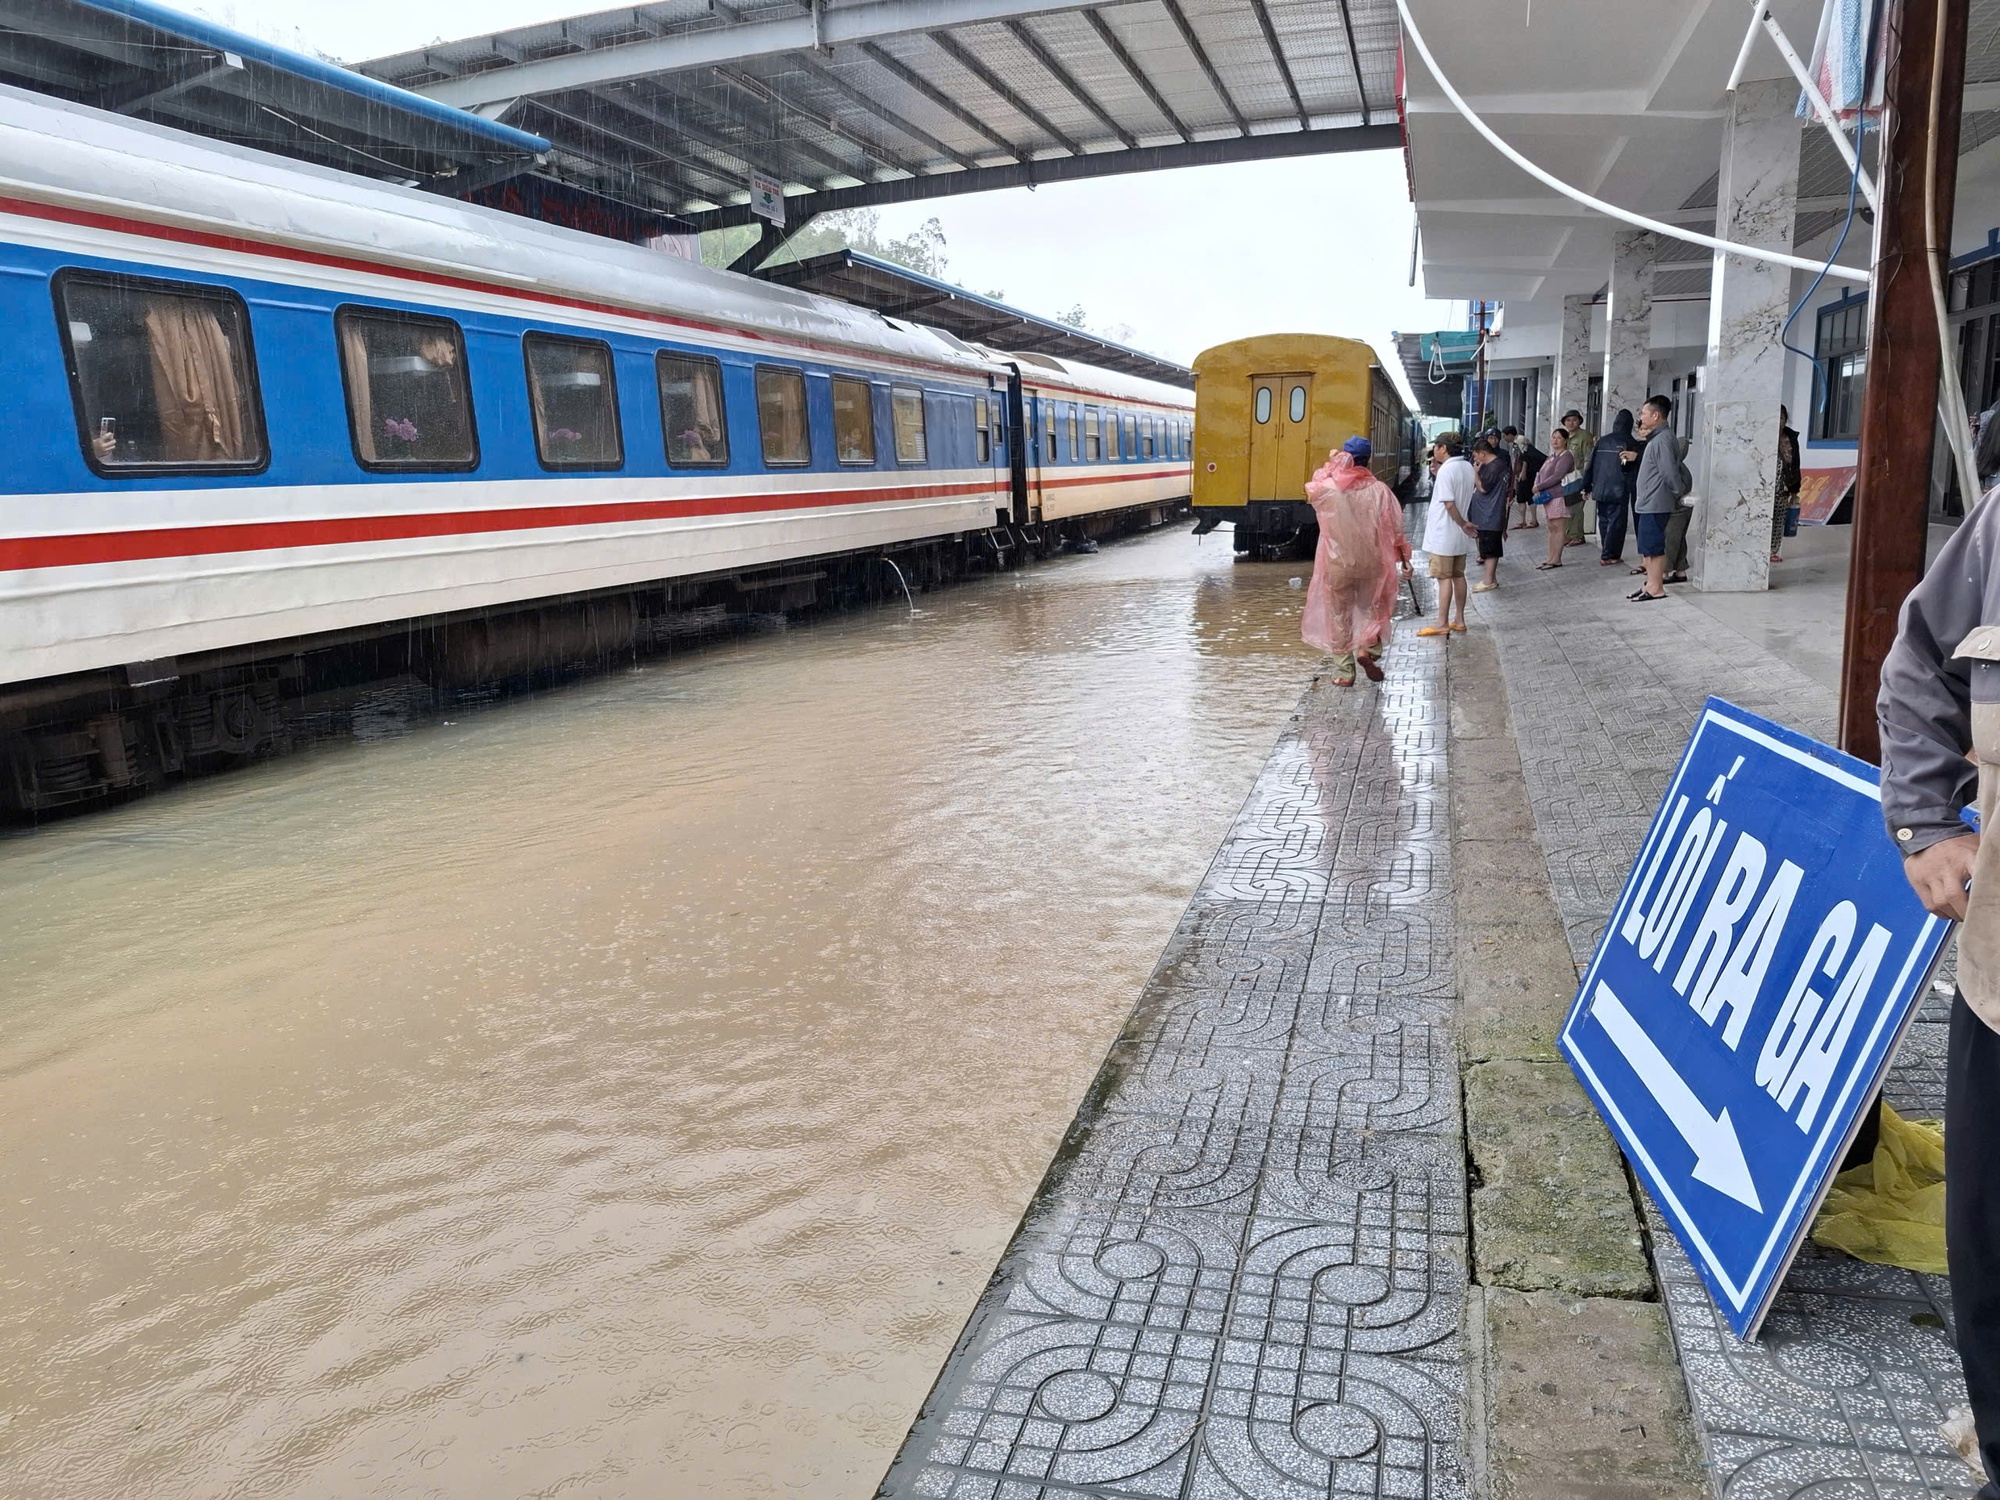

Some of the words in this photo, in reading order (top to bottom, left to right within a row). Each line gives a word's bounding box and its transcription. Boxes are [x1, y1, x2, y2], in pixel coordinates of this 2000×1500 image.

[1621, 755, 1746, 973] LỐI
[1672, 831, 1804, 1052] RA
[1755, 900, 1892, 1134] GA
